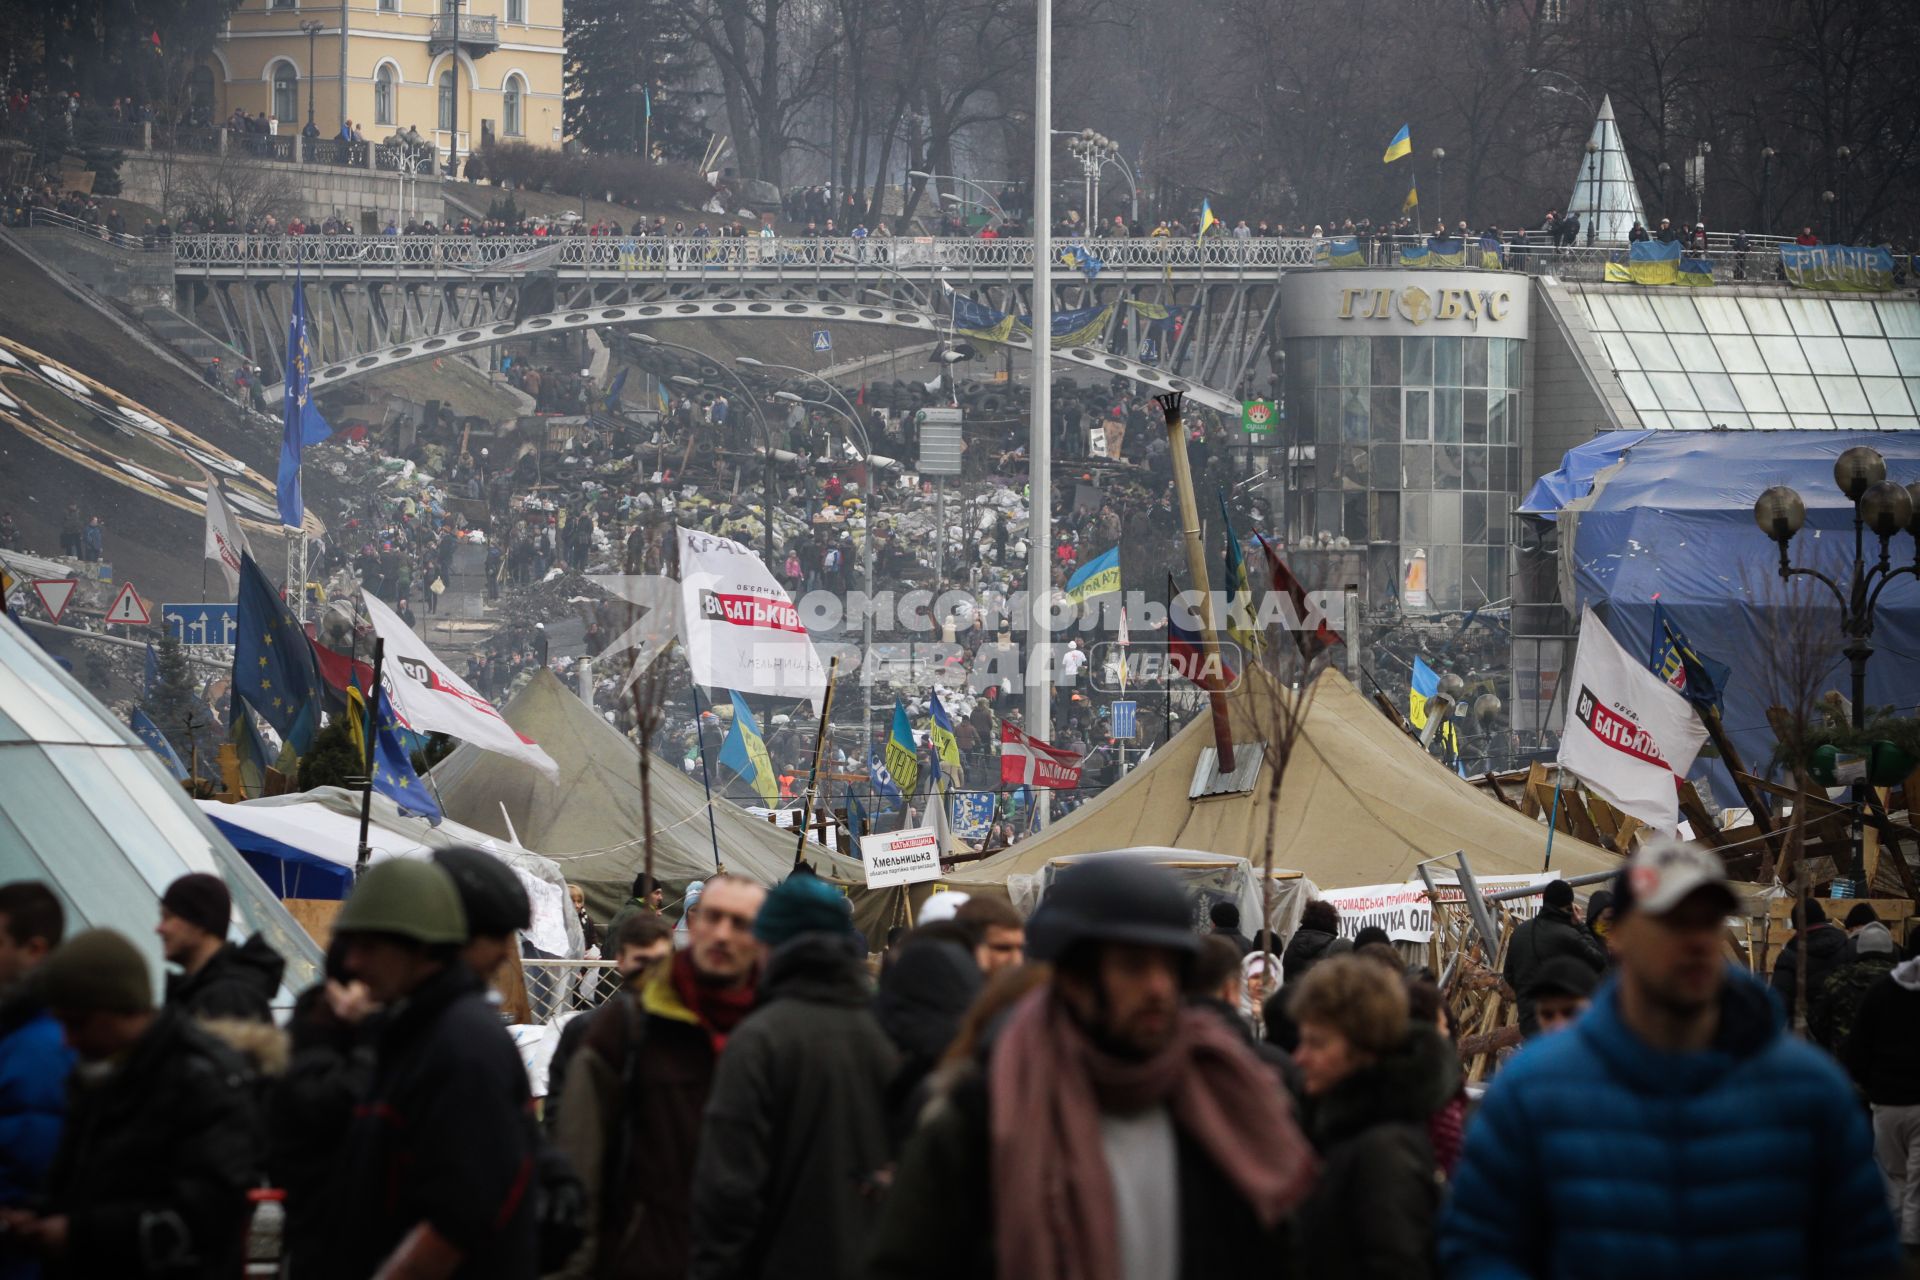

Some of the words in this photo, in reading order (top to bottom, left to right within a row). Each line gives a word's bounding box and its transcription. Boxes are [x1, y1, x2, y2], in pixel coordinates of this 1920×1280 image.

[736, 583, 787, 597] ОБ'ЄДНАН
[1580, 693, 1593, 721] ВО
[1595, 710, 1664, 759] БАТЬКІВ
[872, 851, 931, 869] Хмельницька
